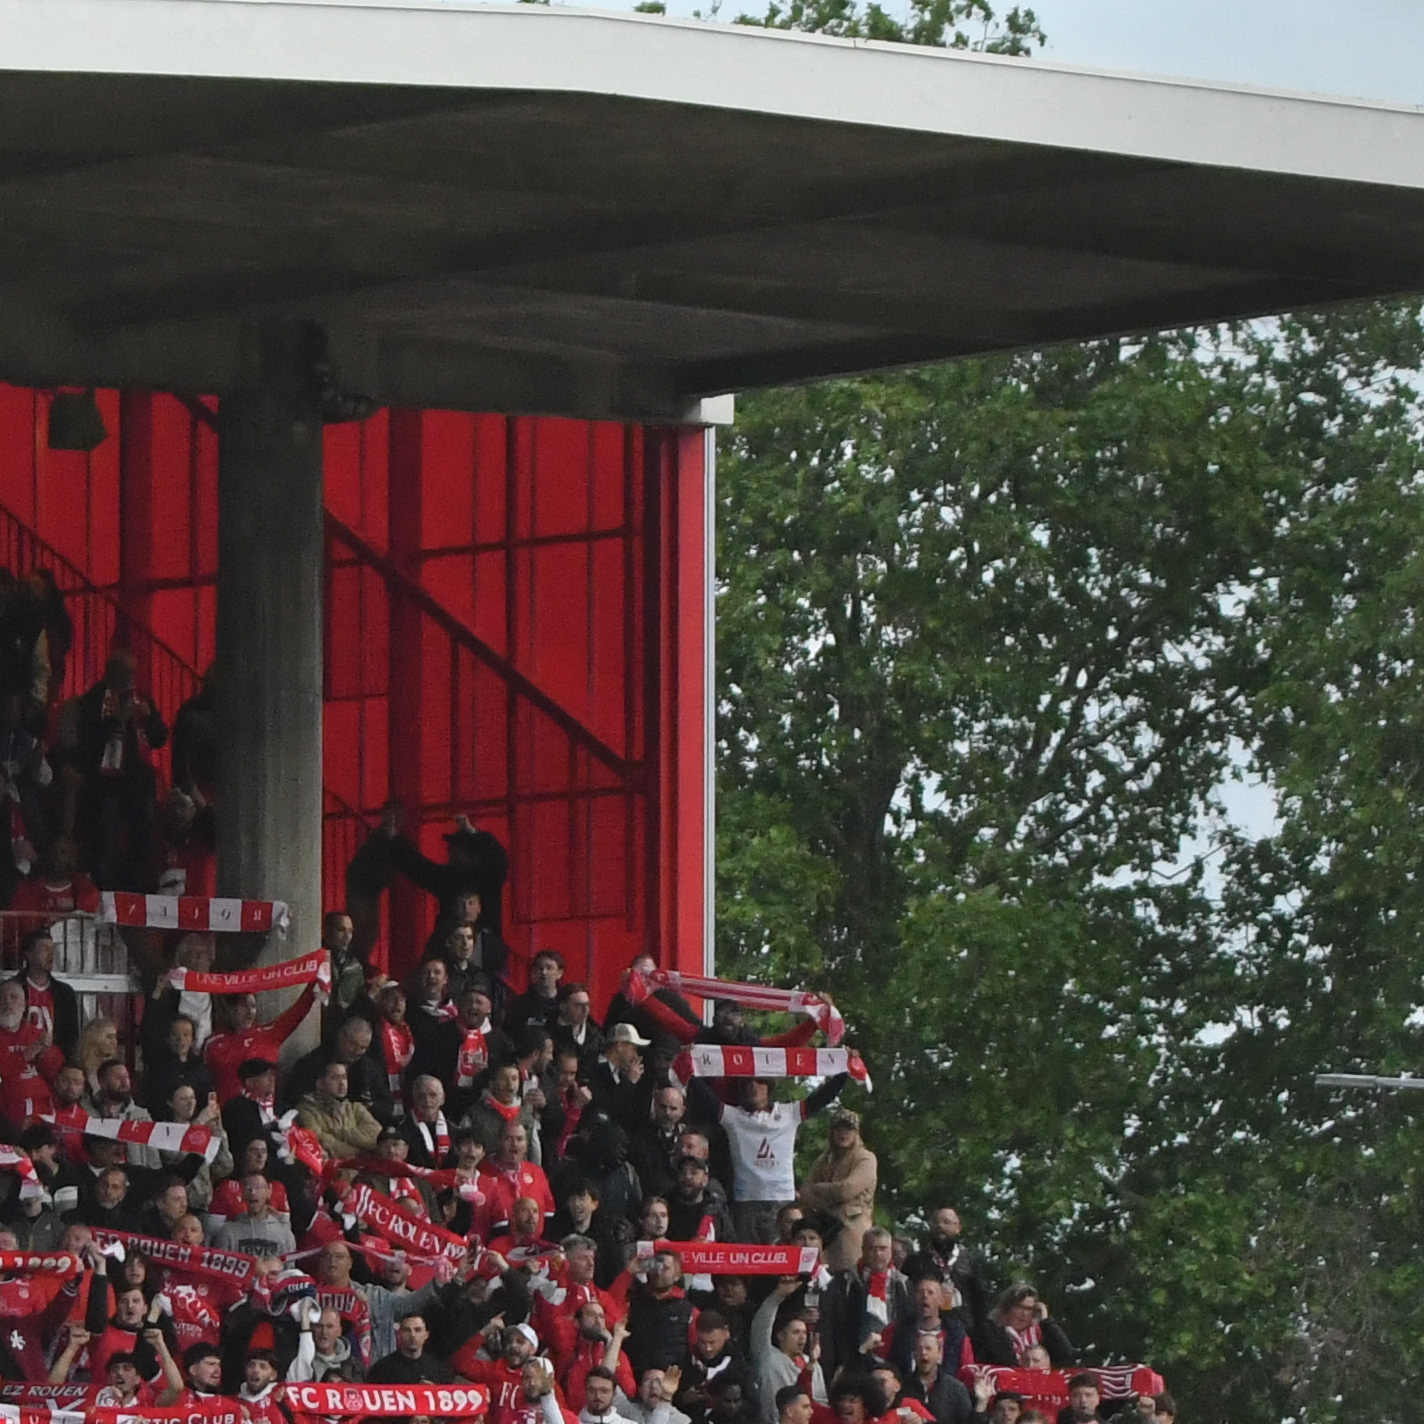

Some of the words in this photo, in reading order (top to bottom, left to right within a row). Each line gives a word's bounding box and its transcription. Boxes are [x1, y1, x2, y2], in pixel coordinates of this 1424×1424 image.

[201, 1249, 250, 1276] 1899
[692, 1252, 727, 1265] VILLE
[730, 1252, 750, 1265] UN
[28, 1384, 88, 1398] ROUEN
[287, 1385, 320, 1410] FC
[423, 1388, 483, 1412] 1899
